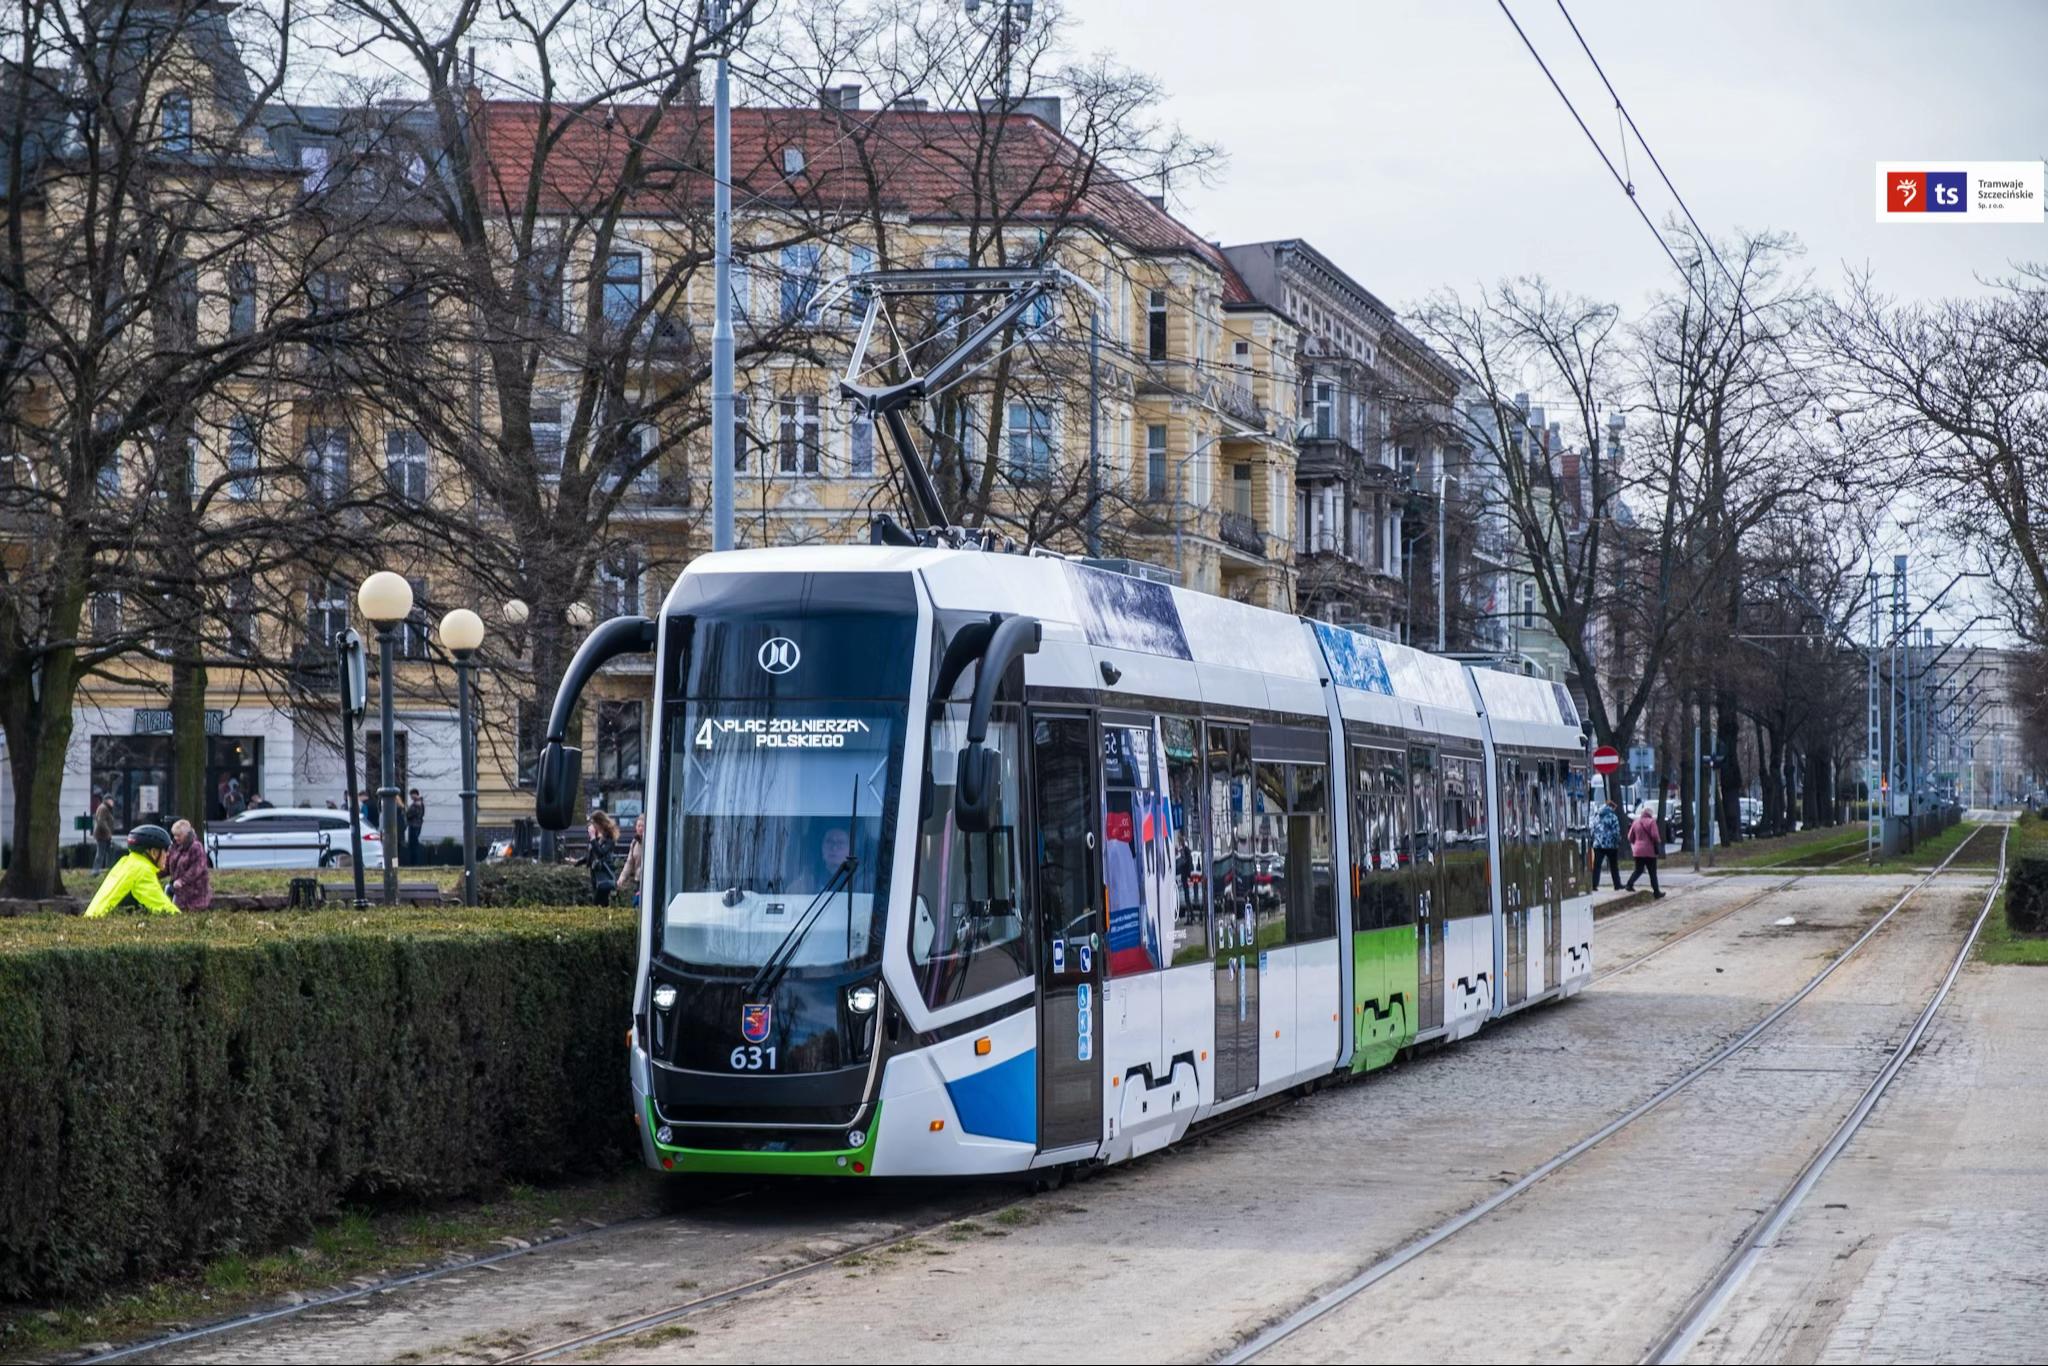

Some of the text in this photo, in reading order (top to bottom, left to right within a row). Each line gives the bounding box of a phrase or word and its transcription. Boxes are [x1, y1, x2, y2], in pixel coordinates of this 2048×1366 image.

[695, 717, 713, 750] 4
[755, 734, 844, 748] POLSKIEGO
[730, 1045, 776, 1071] 631
